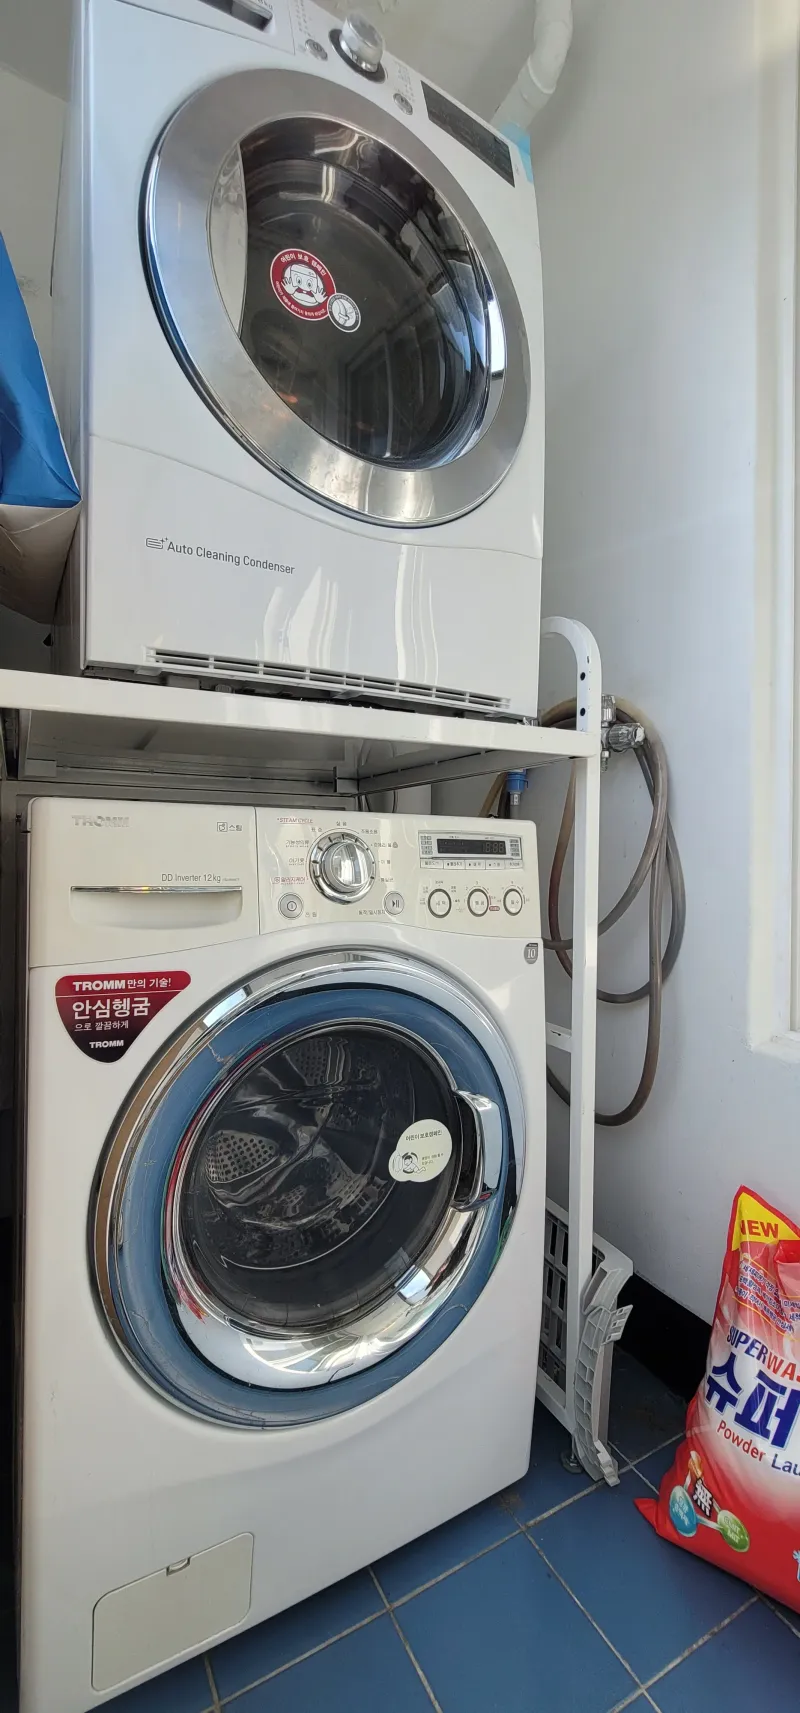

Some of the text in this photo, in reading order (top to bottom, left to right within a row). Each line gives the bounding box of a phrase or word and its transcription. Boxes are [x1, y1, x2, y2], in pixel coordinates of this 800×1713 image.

[167, 541, 295, 575] Auto Cleaning Condenser
[161, 874, 173, 882] DD
[175, 873, 201, 882] Inverter
[528, 948, 536, 959] 10
[149, 977, 171, 988] 기술!
[72, 997, 151, 1019] 안심헹굼
[74, 1020, 129, 1032] 으로 깔끔하게
[89, 1040, 124, 1048] TROMM
[706, 1352, 800, 1448] 슈퍼
[717, 1420, 766, 1461] Powder
